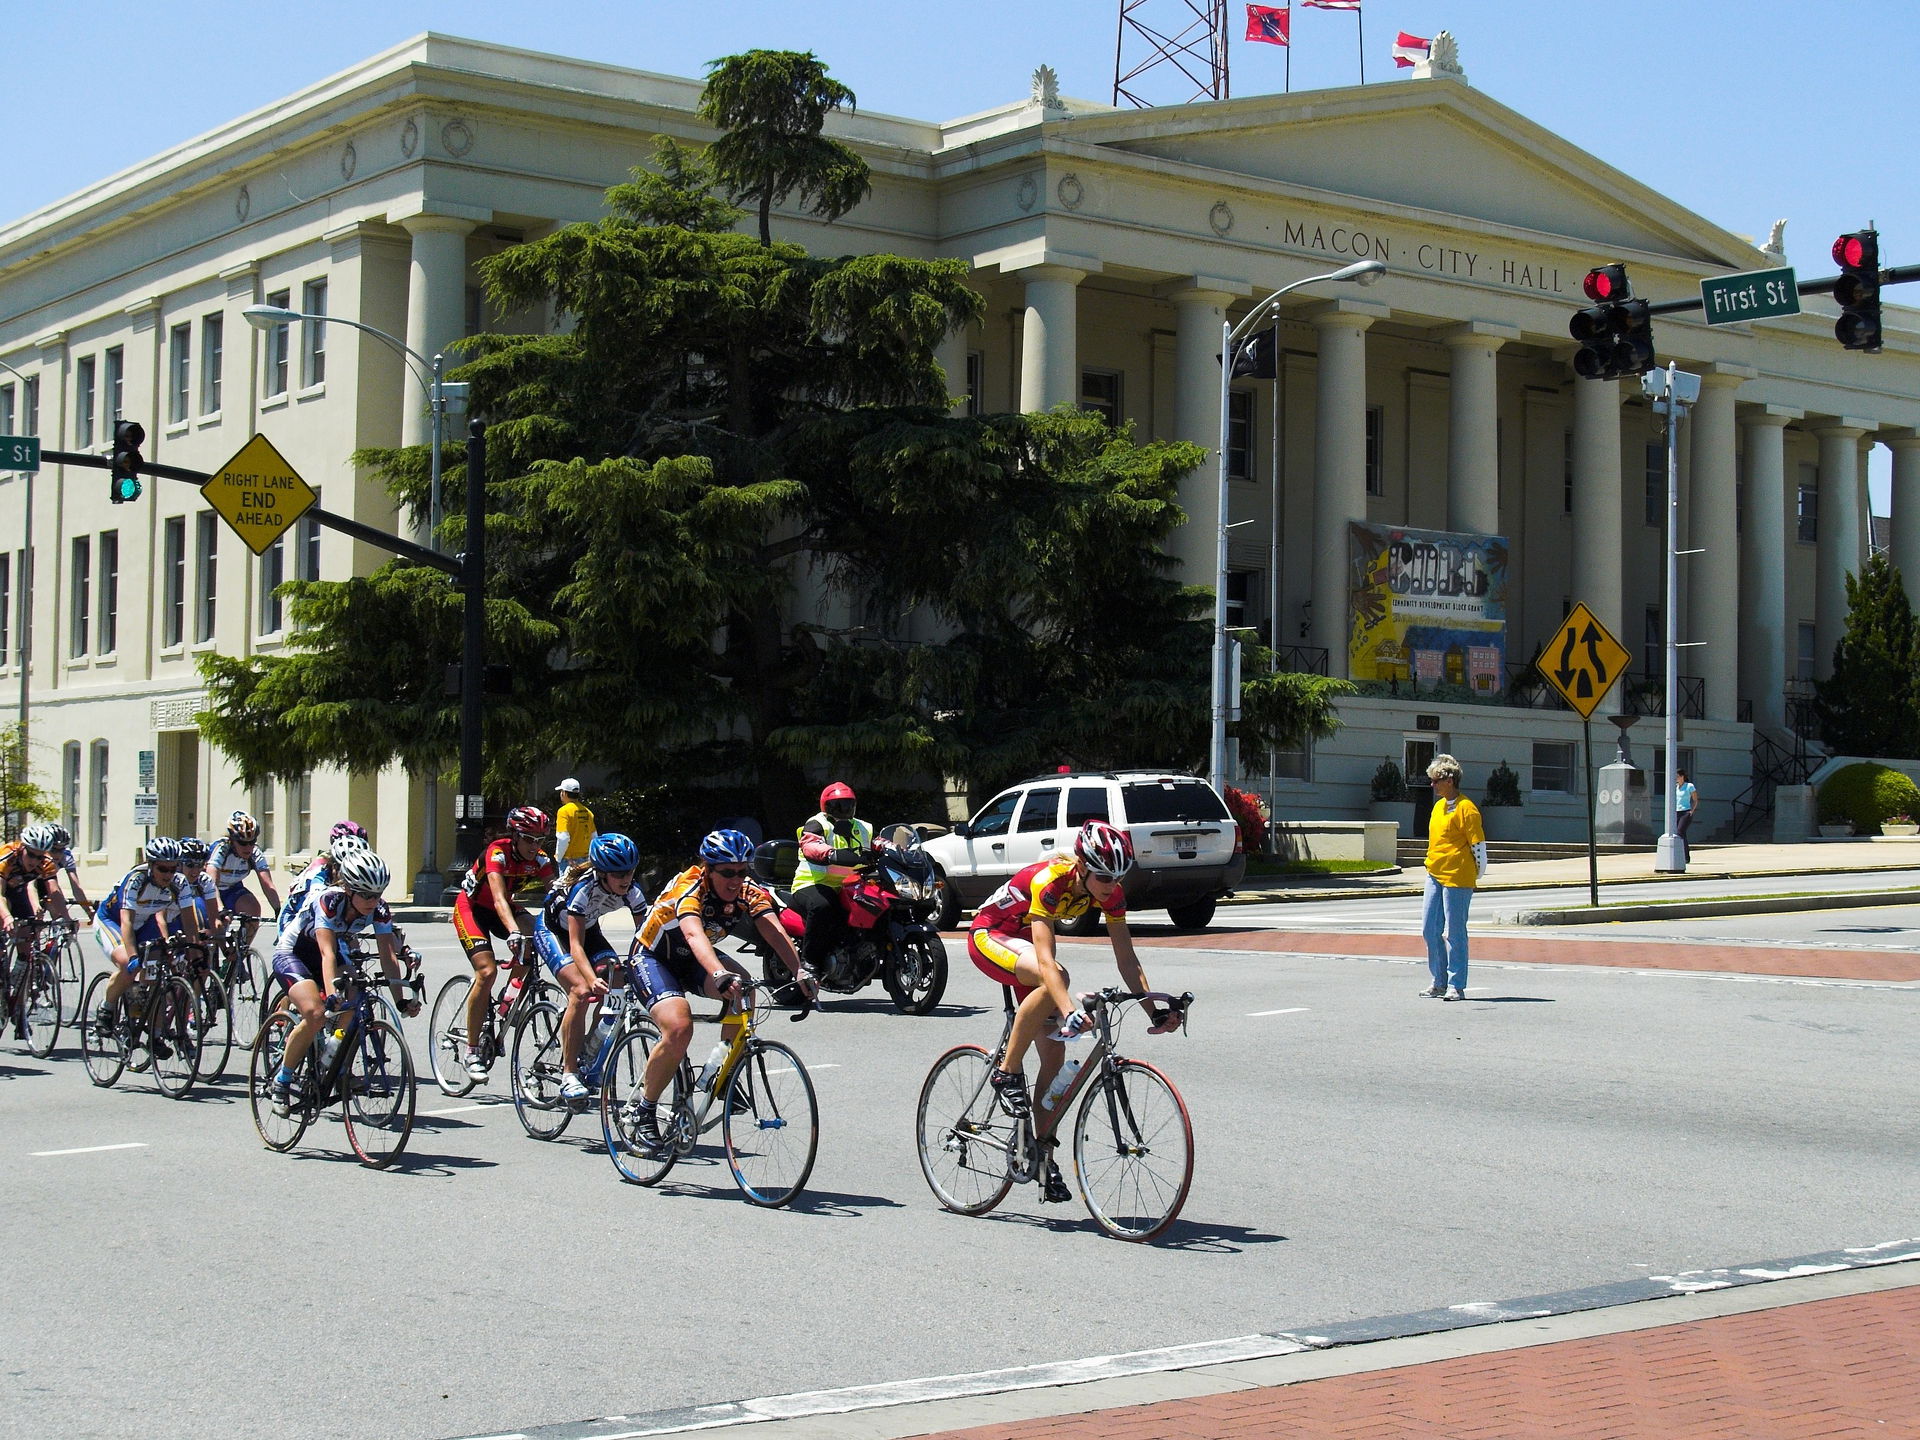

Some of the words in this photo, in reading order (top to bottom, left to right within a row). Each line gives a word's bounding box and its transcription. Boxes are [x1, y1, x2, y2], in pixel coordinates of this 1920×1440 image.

[1284, 219, 1389, 261] MACON
[1418, 244, 1478, 277] CITY
[1502, 260, 1562, 293] HALL
[1713, 284, 1758, 313] First
[1765, 280, 1788, 306] St
[13, 444, 32, 463] St
[224, 472, 259, 488] RIGHT
[263, 475, 295, 490] LANE
[242, 491, 276, 509] END
[235, 511, 283, 527] AHEAD
